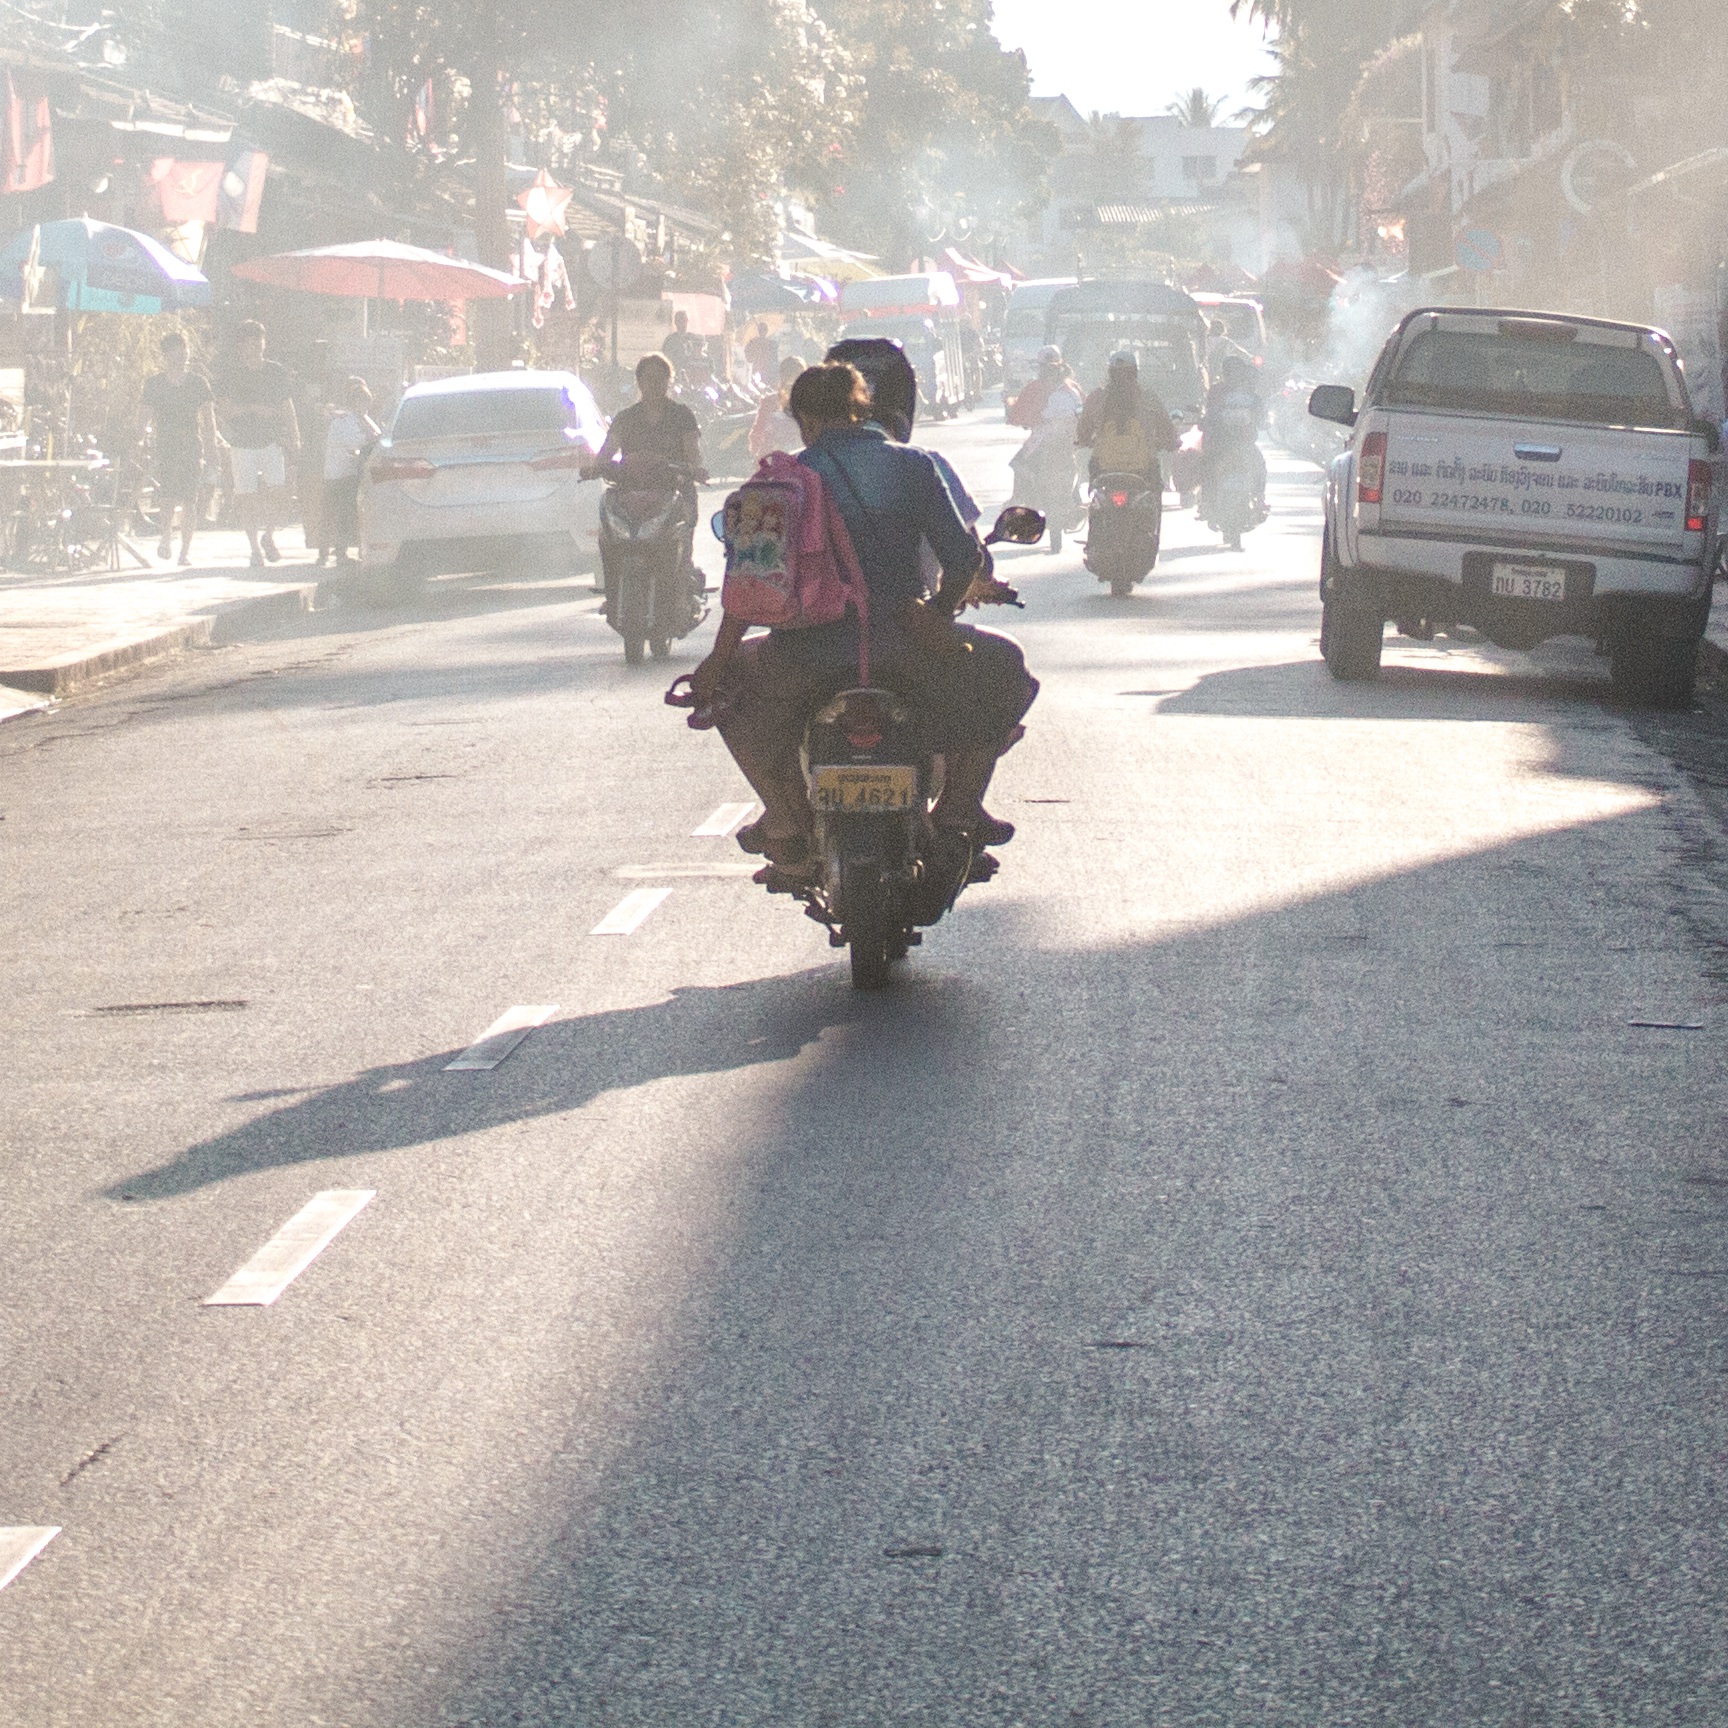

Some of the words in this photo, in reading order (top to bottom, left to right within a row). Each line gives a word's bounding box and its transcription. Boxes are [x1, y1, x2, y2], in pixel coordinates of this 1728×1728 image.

[1655, 481, 1683, 499] PBX
[1393, 488, 1423, 504] 020
[1520, 498, 1552, 515] 020
[1566, 502, 1643, 524] 52220102
[1522, 578, 1562, 599] 3782
[854, 785, 909, 807] 4621
